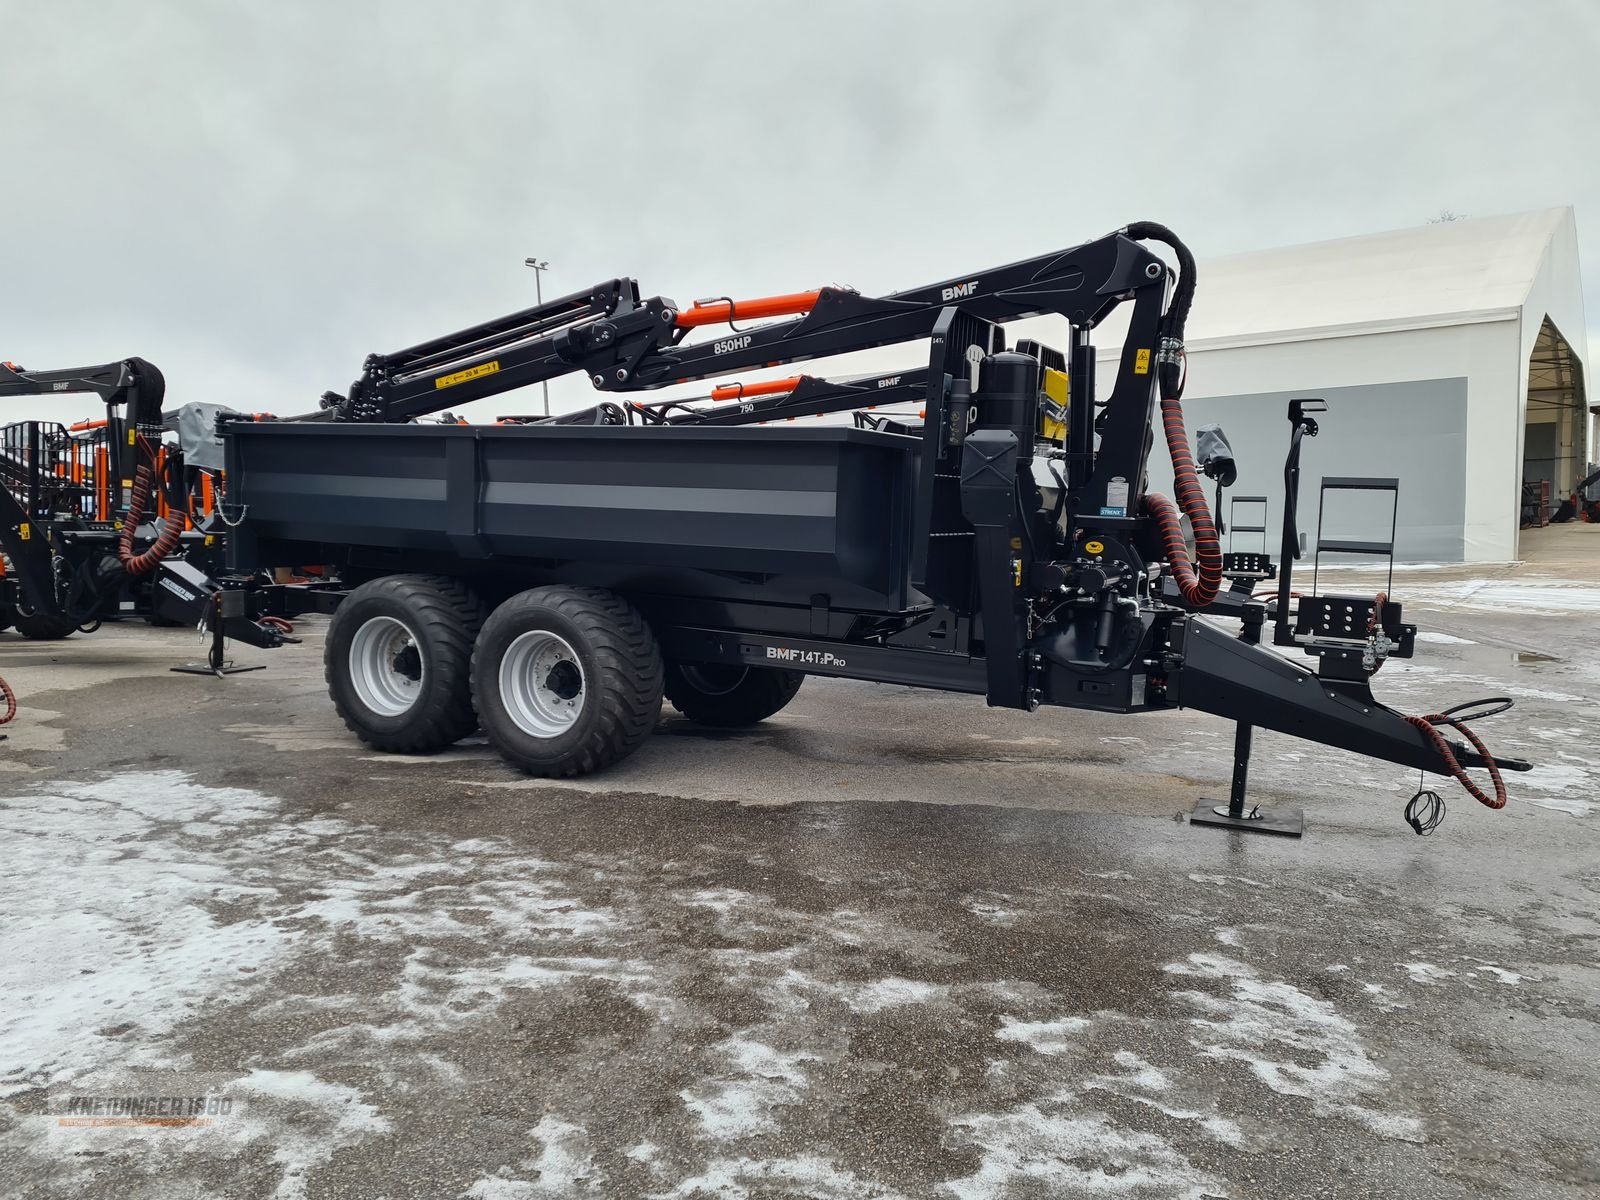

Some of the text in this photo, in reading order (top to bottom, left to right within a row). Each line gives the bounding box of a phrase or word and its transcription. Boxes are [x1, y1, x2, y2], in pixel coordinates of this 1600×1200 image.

[941, 280, 979, 302] BMF
[713, 335, 752, 354] 850HP
[877, 376, 901, 389] BMF
[739, 403, 754, 414] 750
